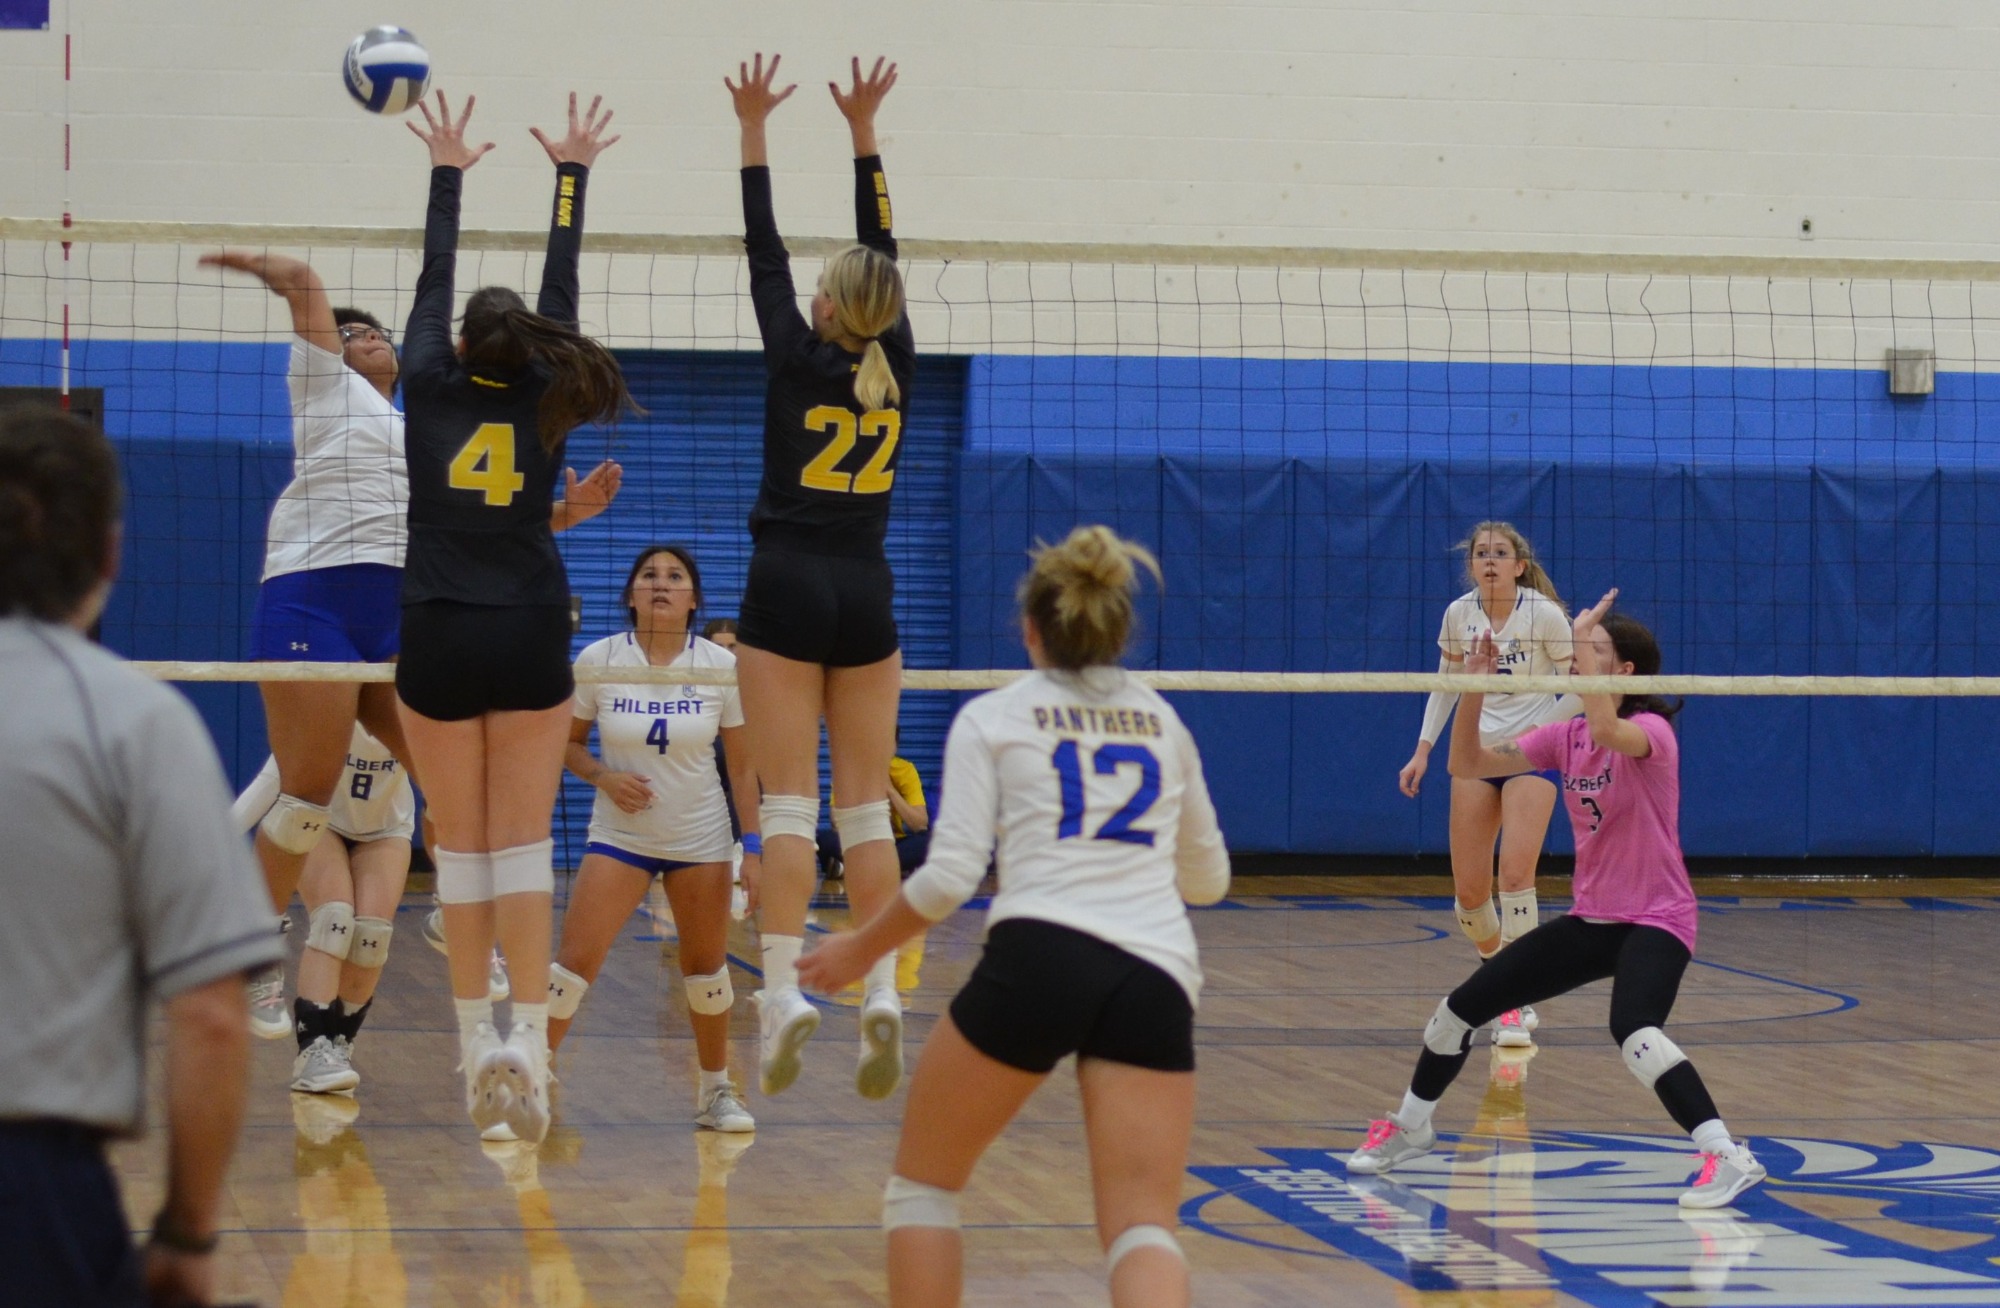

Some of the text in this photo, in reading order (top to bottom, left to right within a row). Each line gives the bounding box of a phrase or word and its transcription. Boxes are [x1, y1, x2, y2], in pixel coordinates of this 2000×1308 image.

[449, 422, 525, 507] 4
[801, 404, 901, 494] 22
[613, 698, 704, 714] HILBERT
[1033, 705, 1163, 738] PANTHERS
[646, 718, 670, 755] 4
[346, 753, 399, 773] LBER
[351, 773, 373, 801] 8
[1052, 738, 1162, 847] 12
[1581, 797, 1603, 832] 3
[1235, 1168, 1562, 1285] HILBERT COLLEGE
